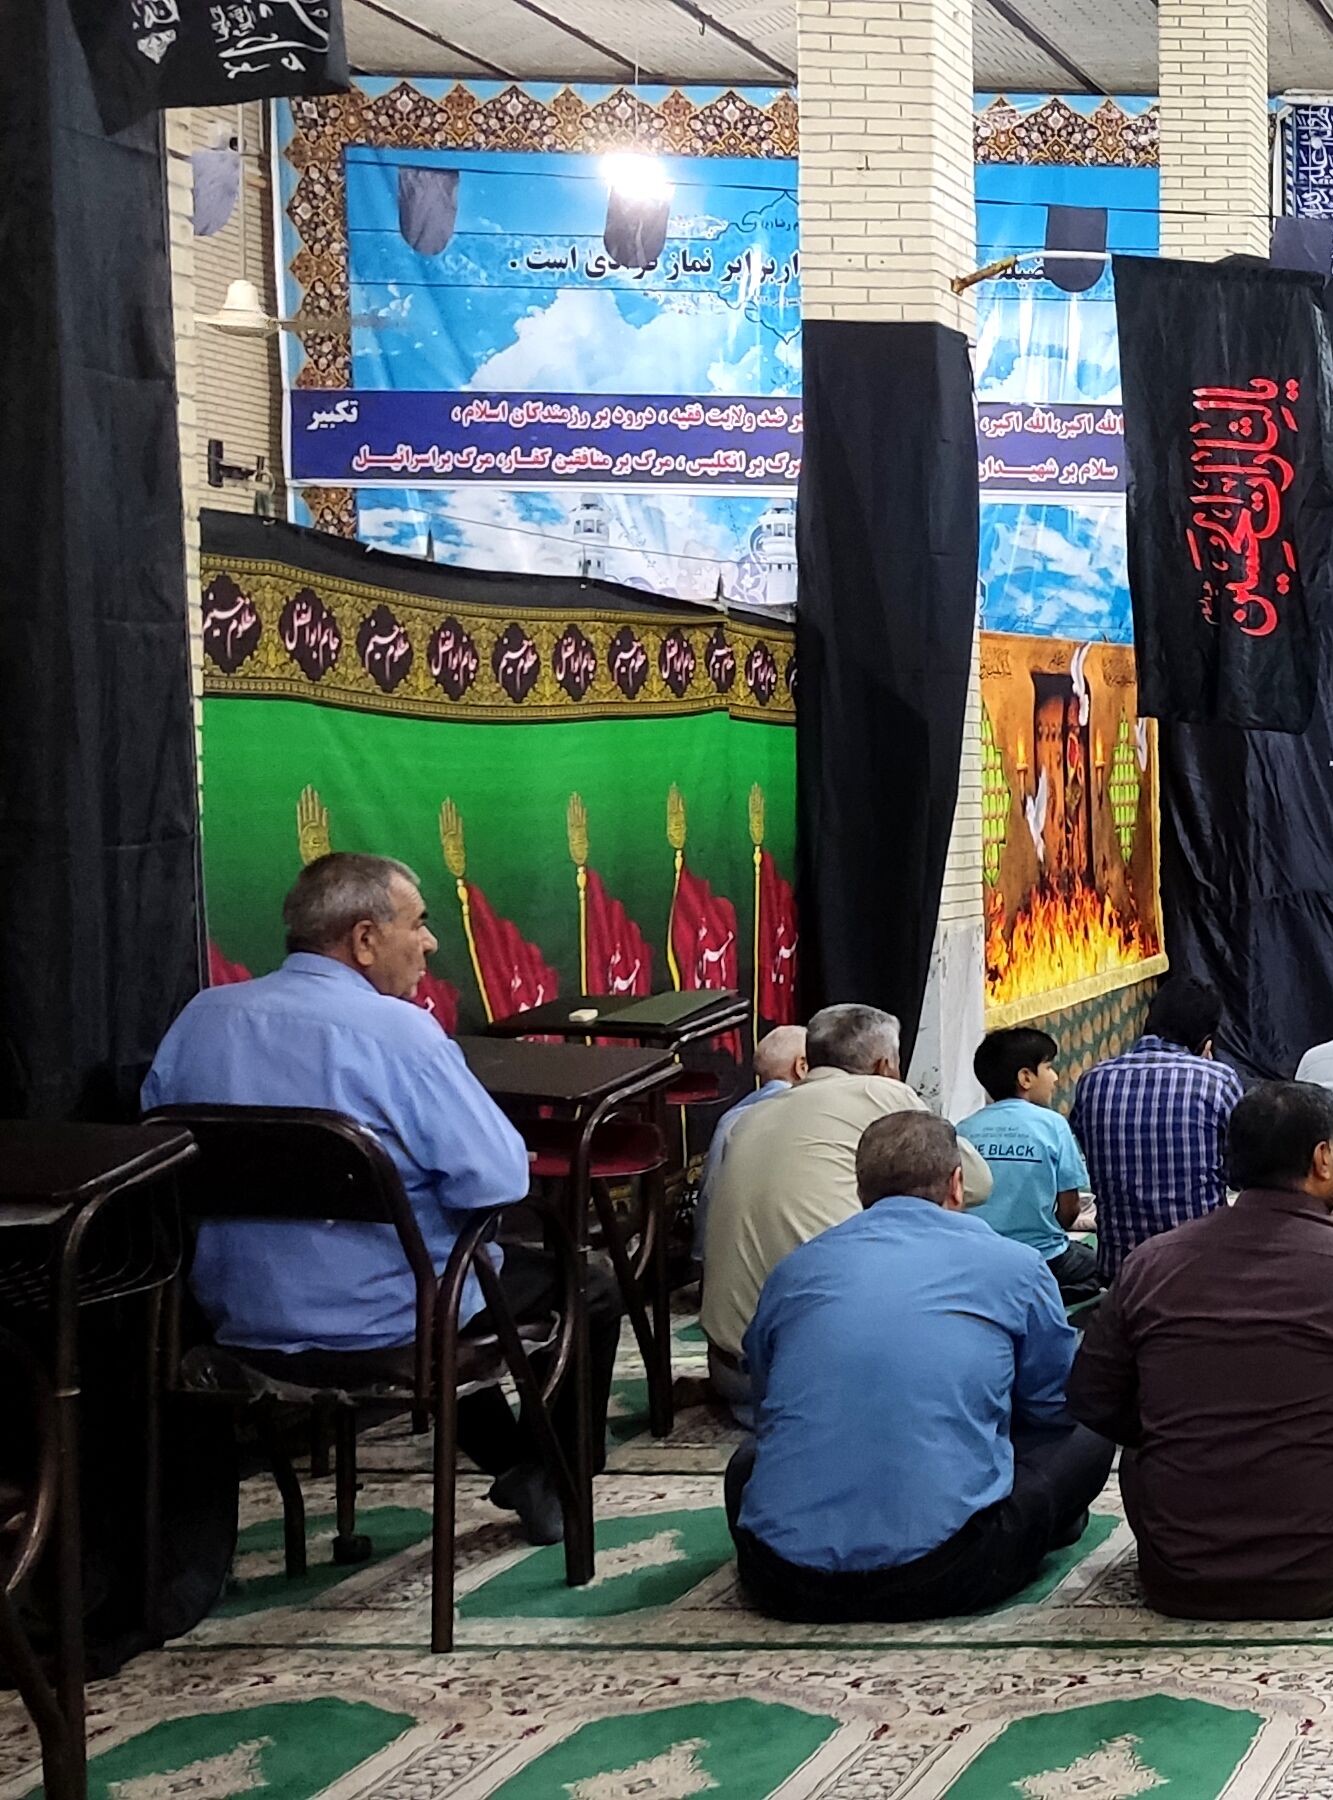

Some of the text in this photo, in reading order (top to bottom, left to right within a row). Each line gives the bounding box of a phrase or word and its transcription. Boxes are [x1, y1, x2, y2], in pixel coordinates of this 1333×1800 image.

[526, 246, 577, 270] است
[667, 246, 712, 280] نماز
[307, 400, 358, 430] تکبیر
[509, 401, 591, 430] رزمندگان
[592, 407, 611, 431] بر
[612, 404, 656, 430] درود
[669, 403, 704, 430] فقیه
[706, 405, 757, 432] ولایت
[757, 406, 787, 429] ضد
[453, 448, 492, 475] مرگ
[553, 448, 612, 475] منافقین
[612, 452, 632, 474] بر
[633, 449, 675, 476] مرگ
[745, 456, 764, 477] بر
[1059, 460, 1078, 485] بر
[1079, 457, 1118, 484] سلام
[988, 1143, 1035, 1157] BLACK
